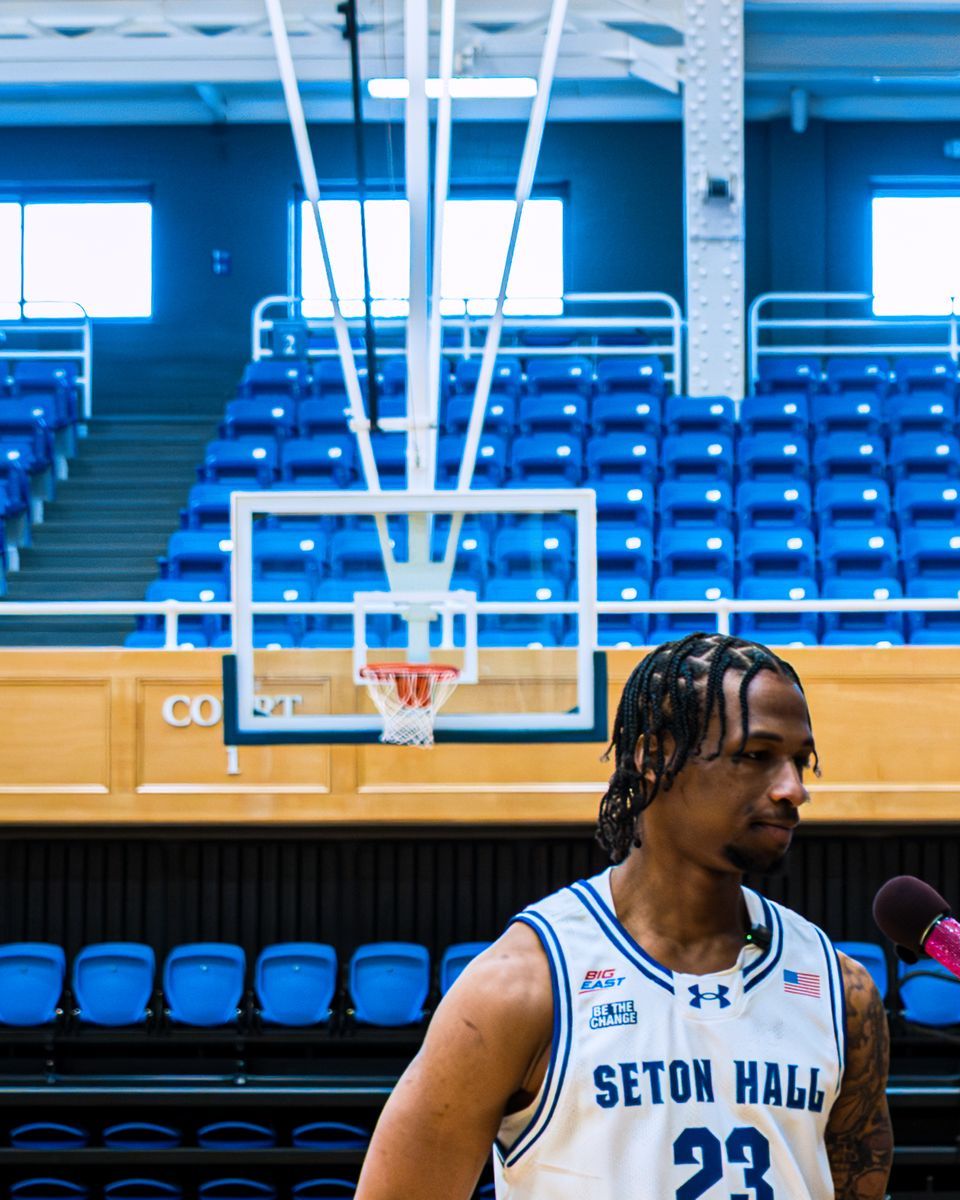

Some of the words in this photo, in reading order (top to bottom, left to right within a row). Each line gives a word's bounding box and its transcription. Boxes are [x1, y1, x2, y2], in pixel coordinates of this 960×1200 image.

[585, 969, 615, 980] BIG
[580, 977, 625, 989] EAST
[593, 1006, 609, 1017] BE
[611, 1001, 633, 1013] THE
[590, 1012, 636, 1028] CHANGE
[593, 1059, 715, 1109] SETON
[734, 1060, 826, 1112] HALL
